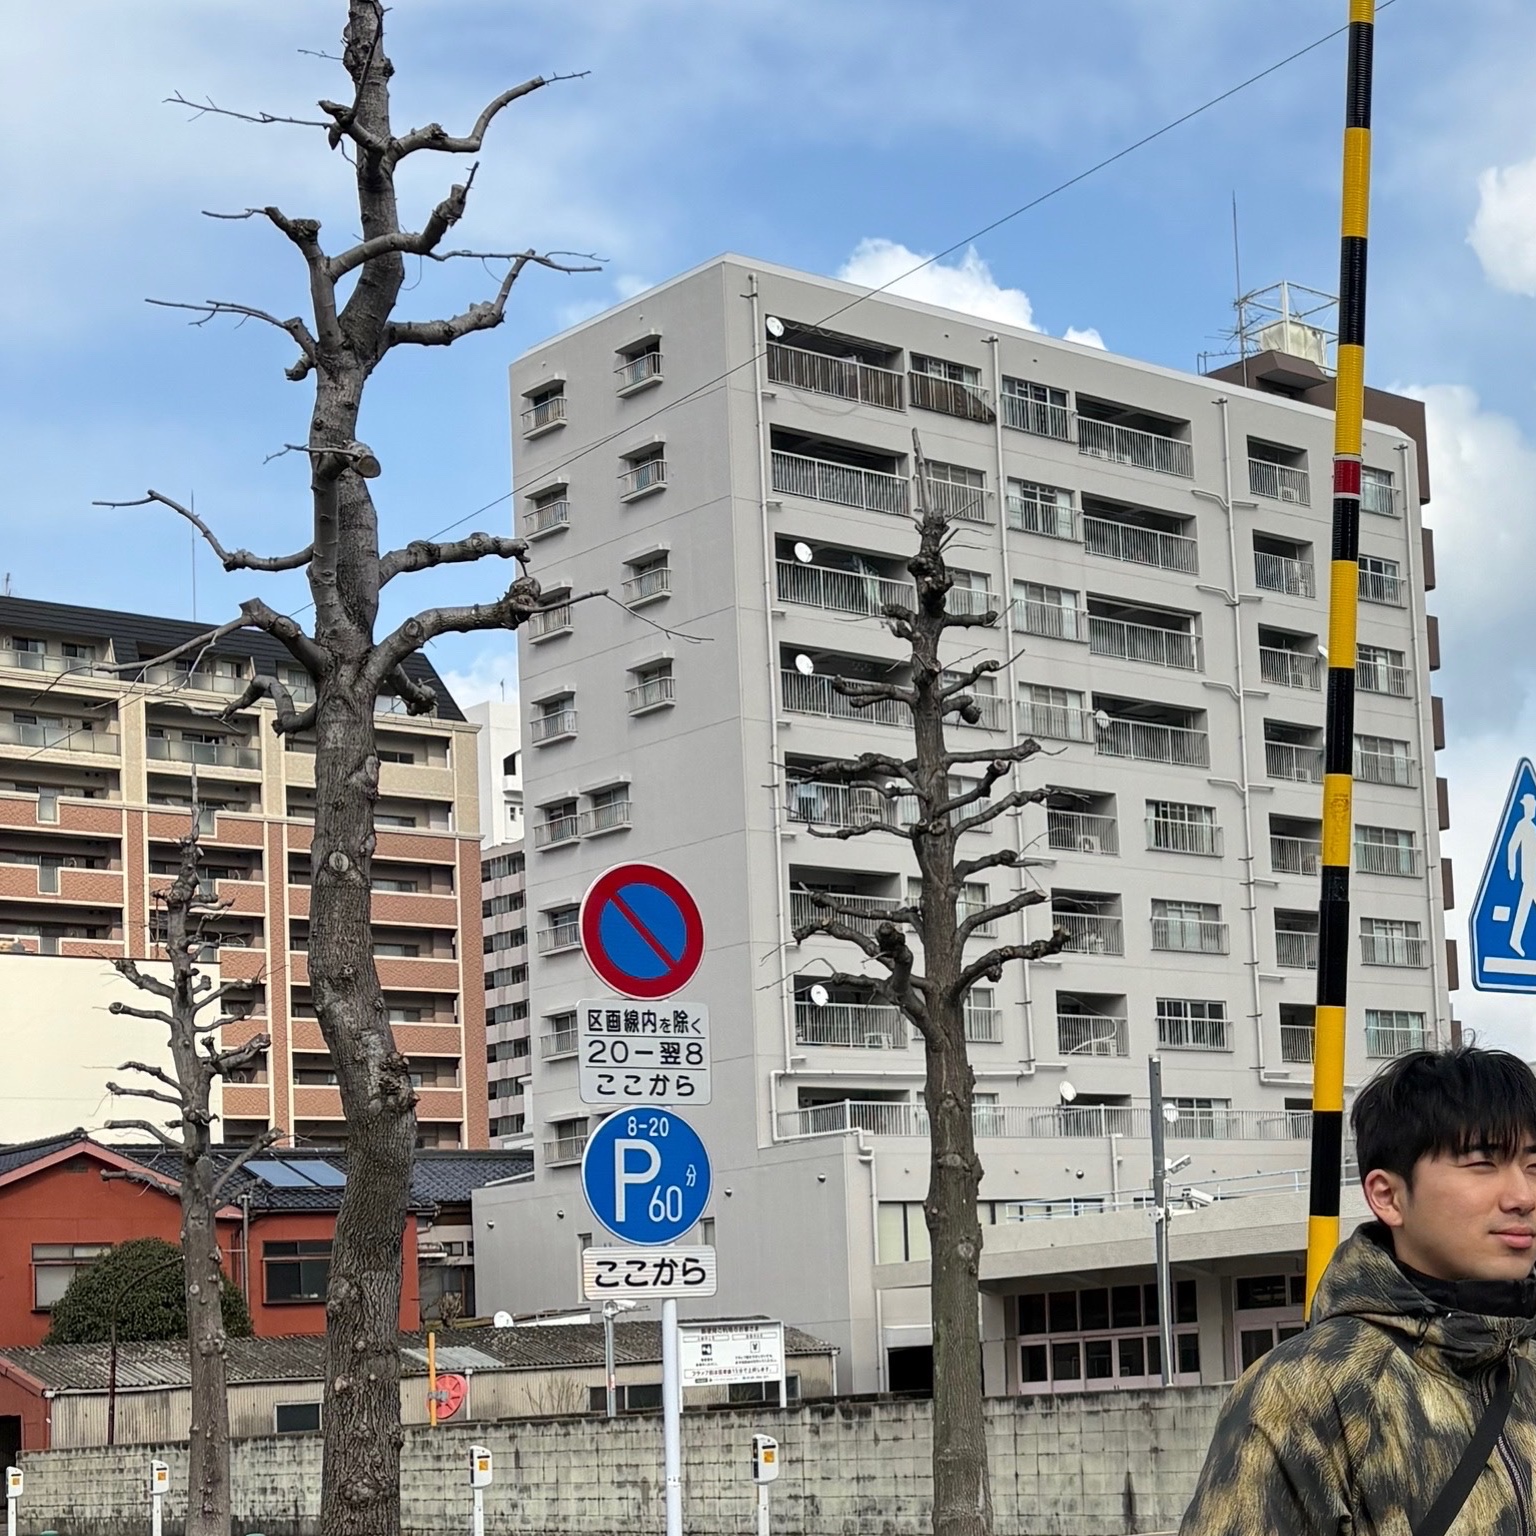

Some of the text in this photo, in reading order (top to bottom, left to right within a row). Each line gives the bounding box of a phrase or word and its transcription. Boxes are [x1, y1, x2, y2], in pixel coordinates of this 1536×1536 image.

[588, 1009, 701, 1034] 区画線内を除く
[597, 1073, 695, 1096] ここから
[628, 1116, 669, 1137] 8-20
[615, 1138, 661, 1222] P
[595, 1257, 706, 1287] ここから
